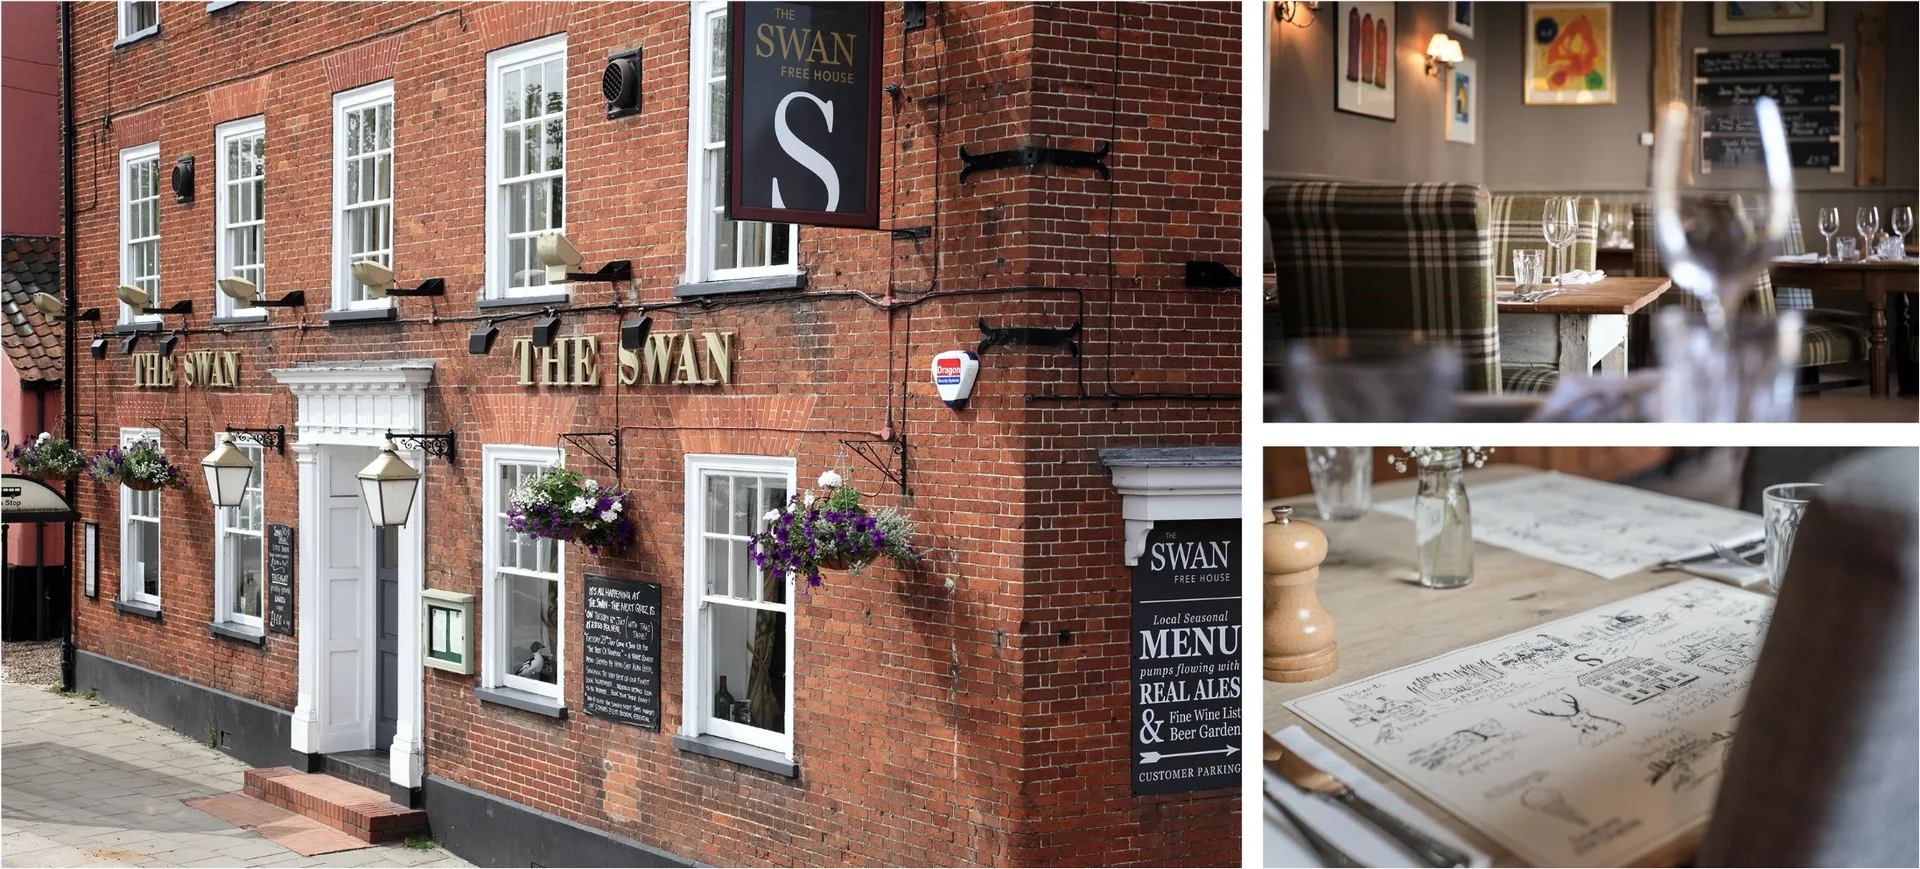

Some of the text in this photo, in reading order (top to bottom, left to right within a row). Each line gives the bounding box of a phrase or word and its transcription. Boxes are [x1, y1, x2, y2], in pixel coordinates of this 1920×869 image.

[775, 8, 795, 20] THE
[756, 23, 857, 67] SWAN
[781, 66, 854, 84] FREE HOUSE
[772, 91, 840, 212] S
[513, 331, 734, 385] THE SWAN
[132, 352, 240, 387] THE SWAN
[938, 366, 961, 376] Dragon
[1151, 541, 1231, 571] SWAN
[1174, 573, 1231, 584] FREE HOUSE
[605, 588, 630, 600] HAPPENING
[632, 591, 641, 600] AT
[611, 600, 620, 611] THE
[620, 602, 634, 612] NEXT
[635, 603, 649, 615] QUIZ
[649, 606, 656, 616] IS
[1153, 610, 1229, 625] Local Seasonal
[1140, 625, 1241, 660] MENU
[1140, 660, 1240, 679] pumps flowing with
[1574, 653, 1603, 667] S
[1140, 676, 1241, 705] REAL ALES
[1169, 706, 1241, 723] Fine Wine List
[1140, 708, 1164, 744] &
[1170, 722, 1241, 741] Beer Garden
[1139, 763, 1241, 782] CUSTOMER PARKING
